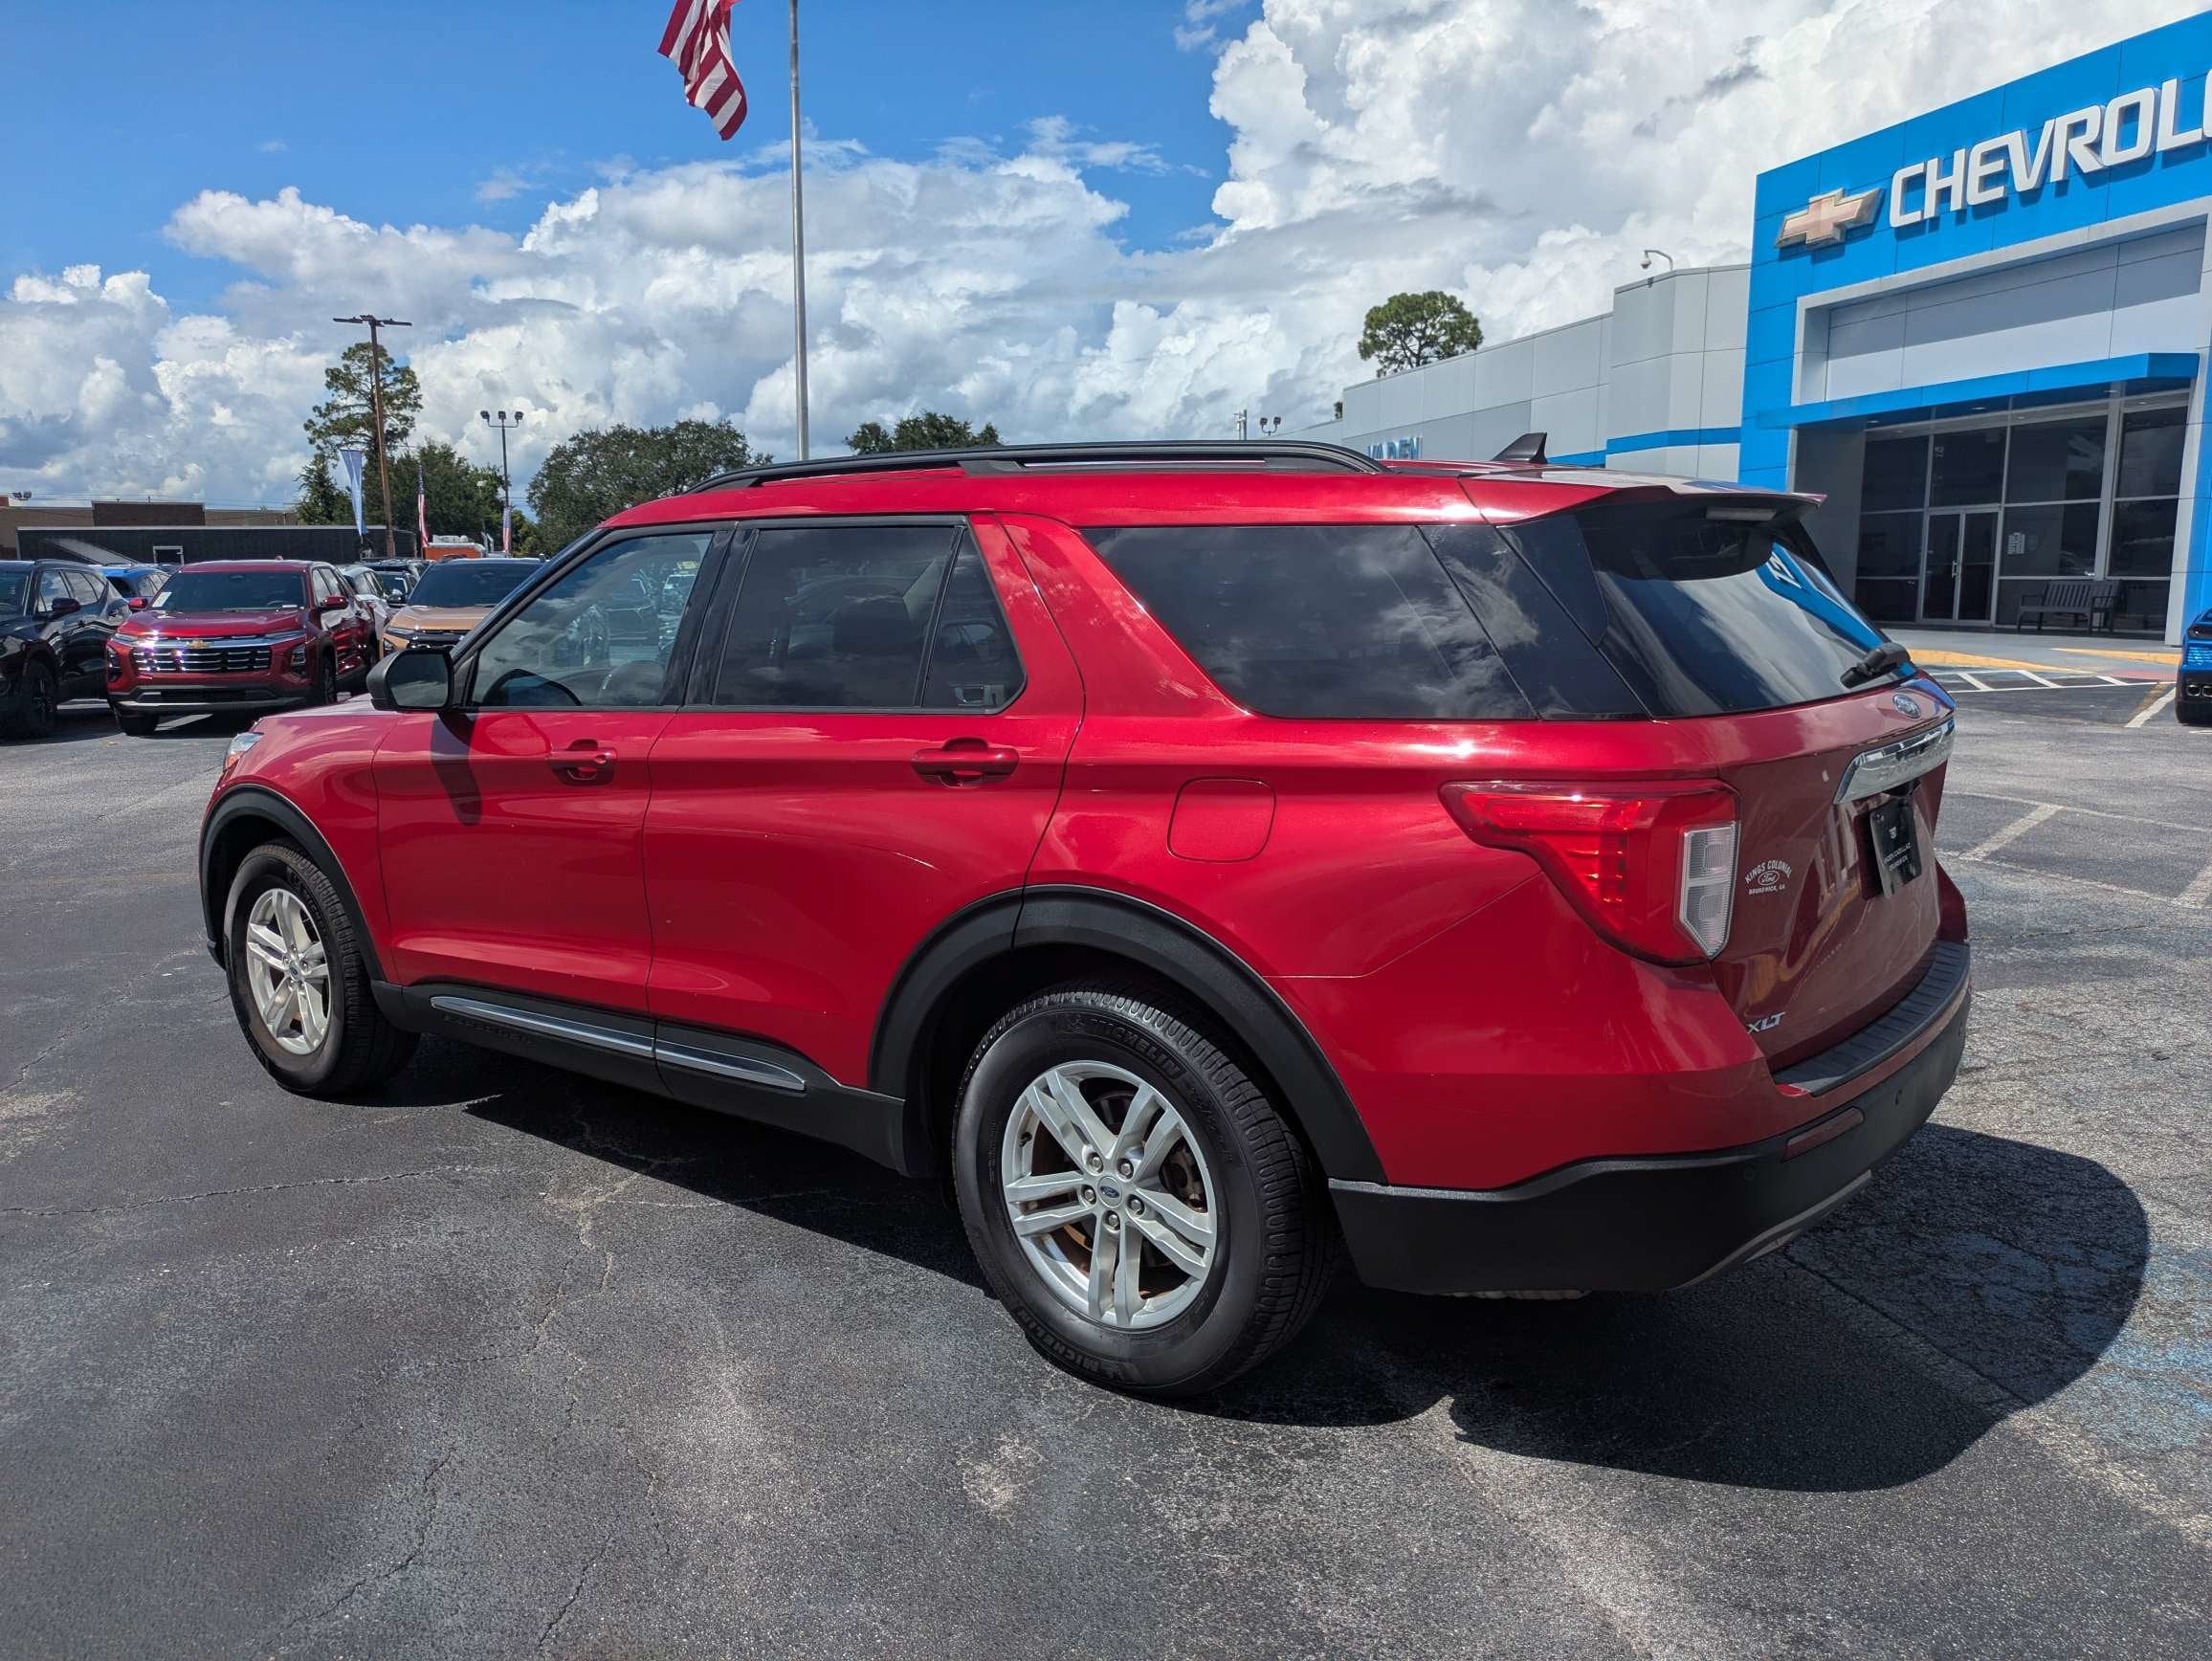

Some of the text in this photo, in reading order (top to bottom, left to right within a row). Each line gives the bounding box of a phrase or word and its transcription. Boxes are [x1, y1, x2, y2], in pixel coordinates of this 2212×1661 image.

[1890, 69, 2212, 229] CHEVROL
[1745, 862, 1766, 884] KINGS
[1746, 1011, 1786, 1034] XLT
